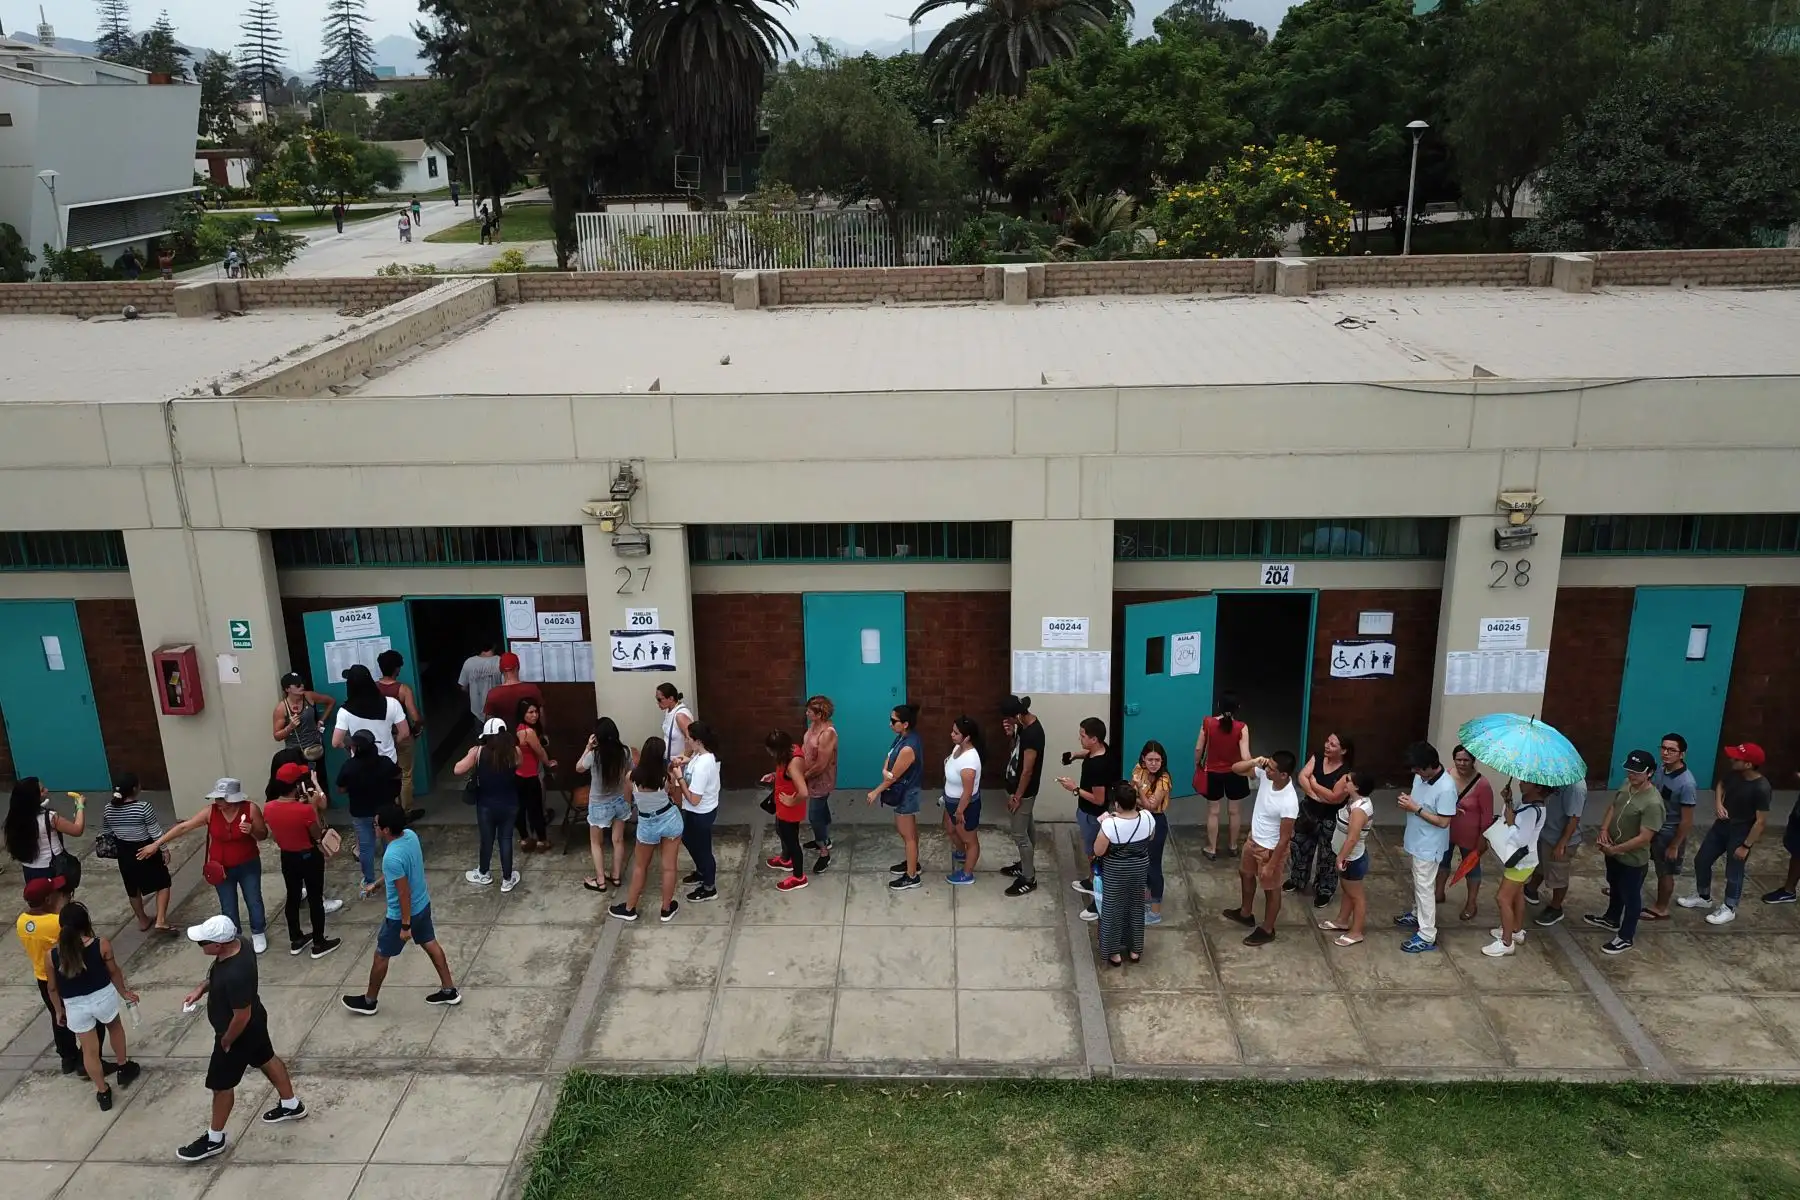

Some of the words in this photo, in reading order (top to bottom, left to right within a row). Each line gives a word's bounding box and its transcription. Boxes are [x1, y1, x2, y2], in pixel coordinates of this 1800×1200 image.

[1265, 571, 1289, 585] 204
[1489, 559, 1531, 588] 28
[615, 566, 652, 595] 27
[339, 613, 372, 623] 040242
[544, 617, 575, 625] 040243
[632, 616, 653, 625] 200
[1487, 623, 1521, 632] 040245
